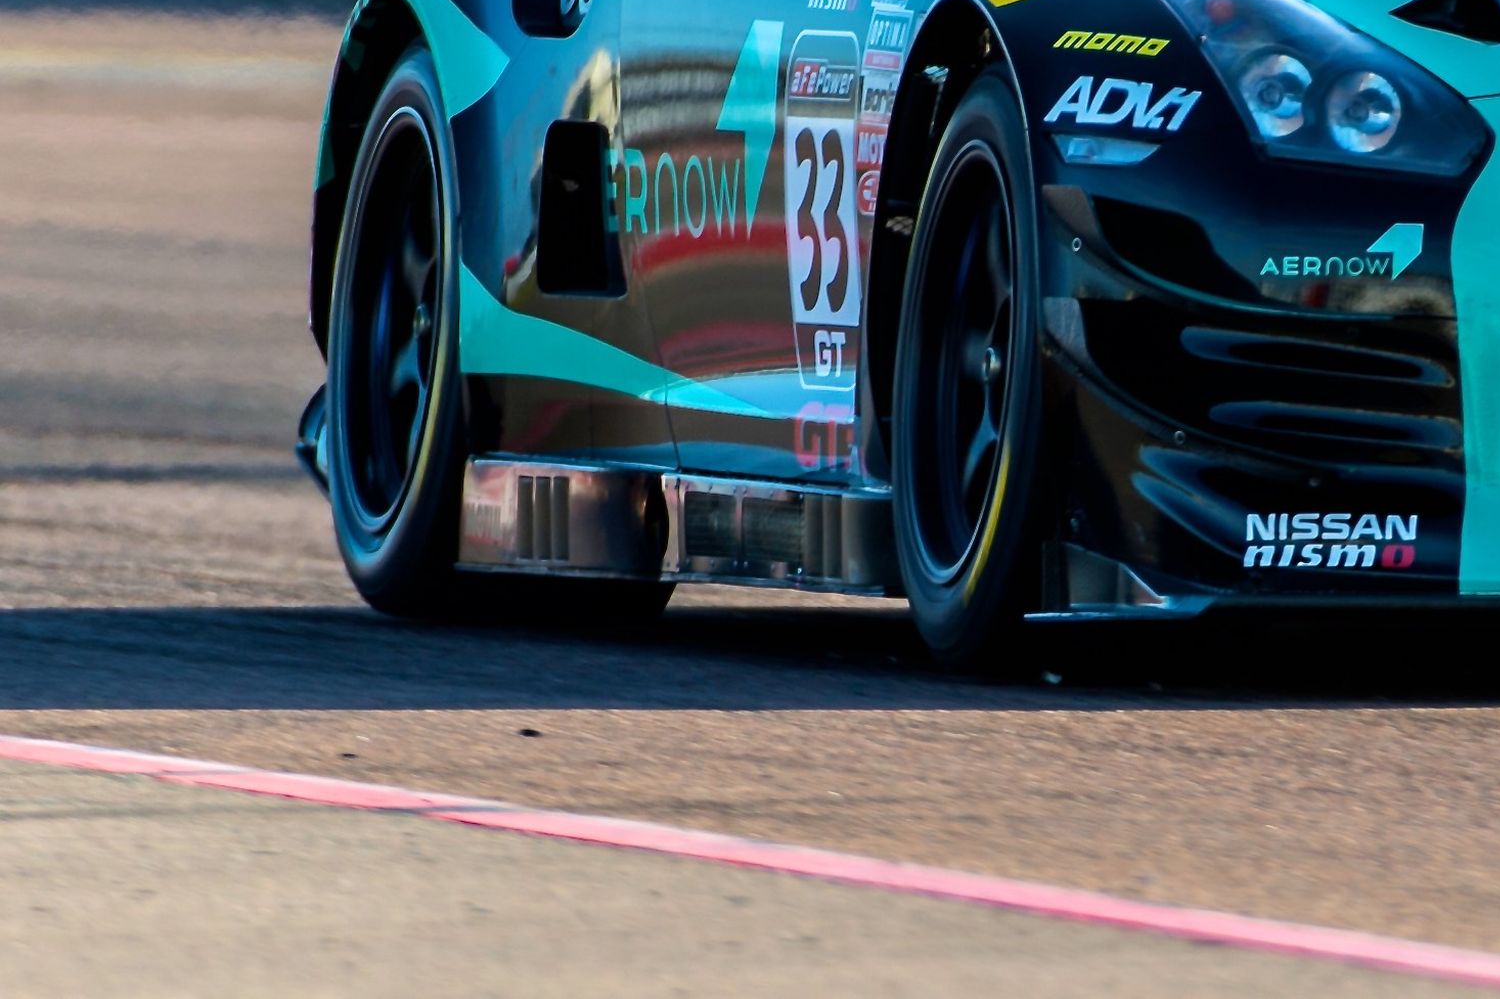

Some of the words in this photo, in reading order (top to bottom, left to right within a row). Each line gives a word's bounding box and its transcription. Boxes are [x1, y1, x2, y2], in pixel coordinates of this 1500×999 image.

[795, 127, 848, 313] 33
[814, 330, 846, 378] GT
[1246, 513, 1418, 541] NISSAN
